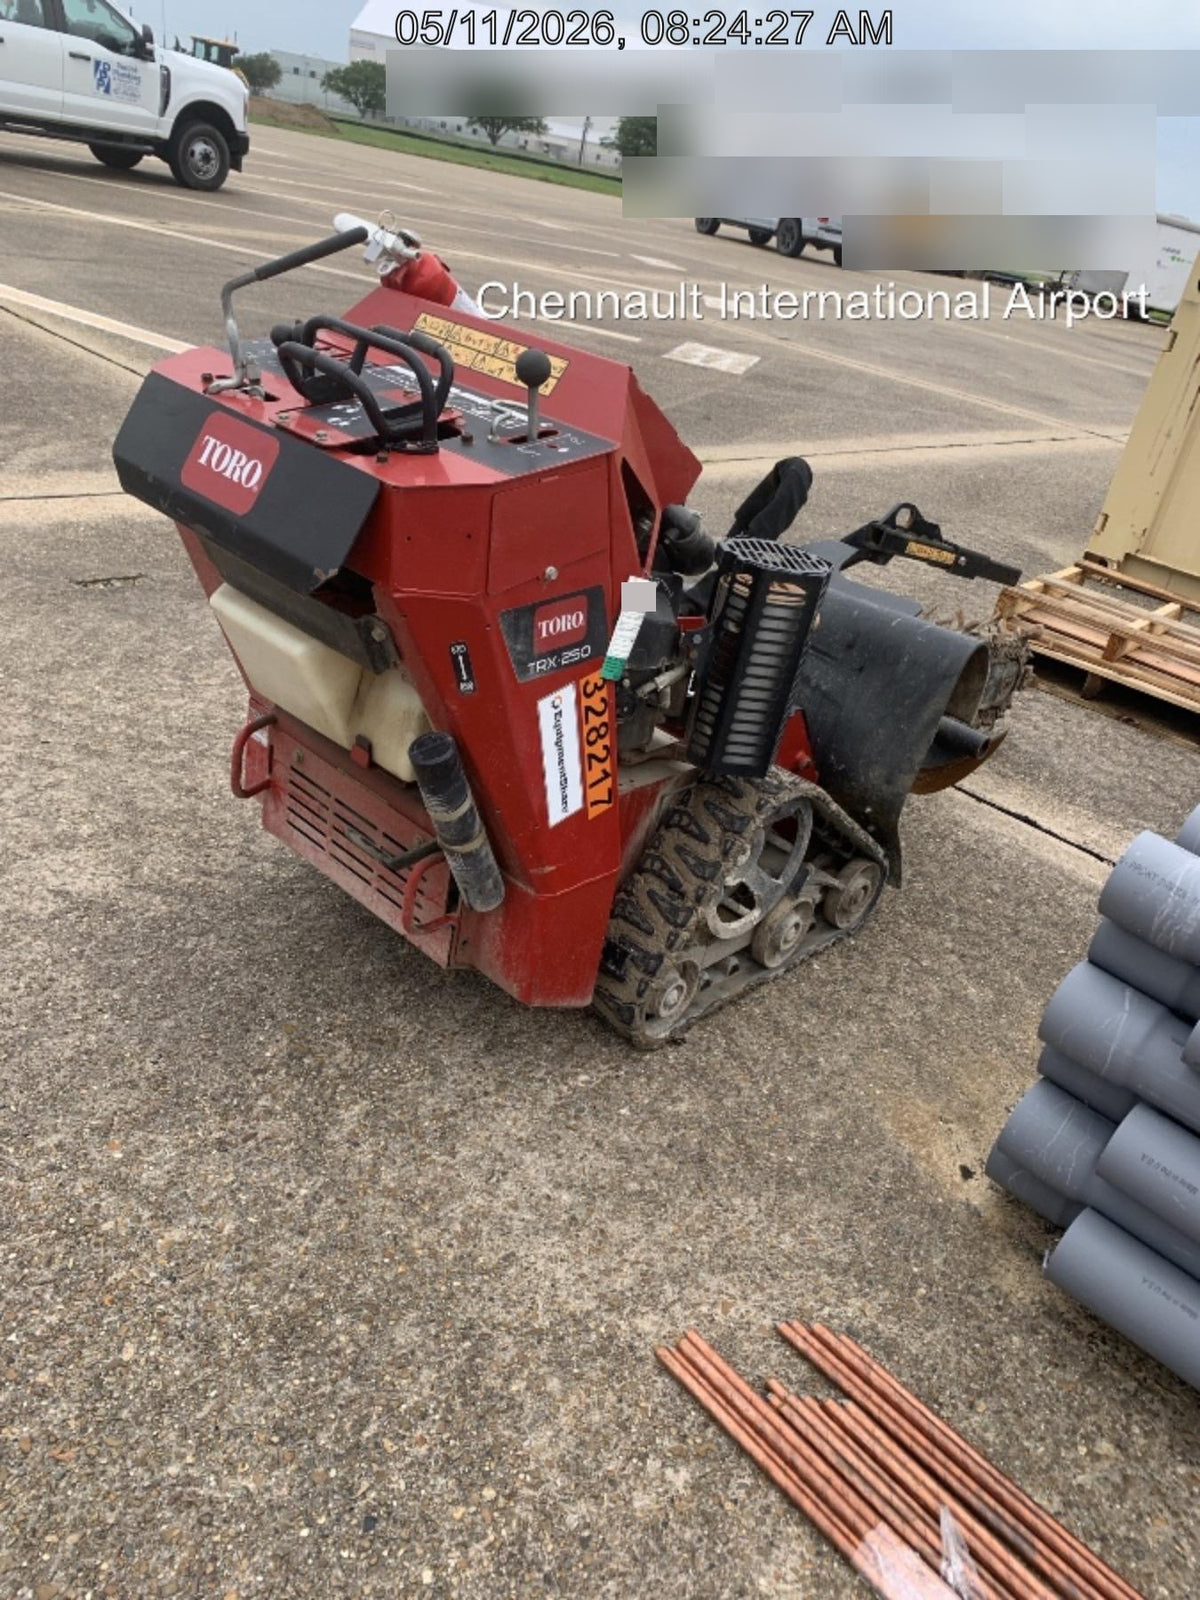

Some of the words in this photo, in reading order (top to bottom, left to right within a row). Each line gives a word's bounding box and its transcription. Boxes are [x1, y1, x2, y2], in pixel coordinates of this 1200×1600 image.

[198, 434, 262, 489] TORO
[538, 611, 584, 638] TORO
[582, 676, 613, 808] 328217
